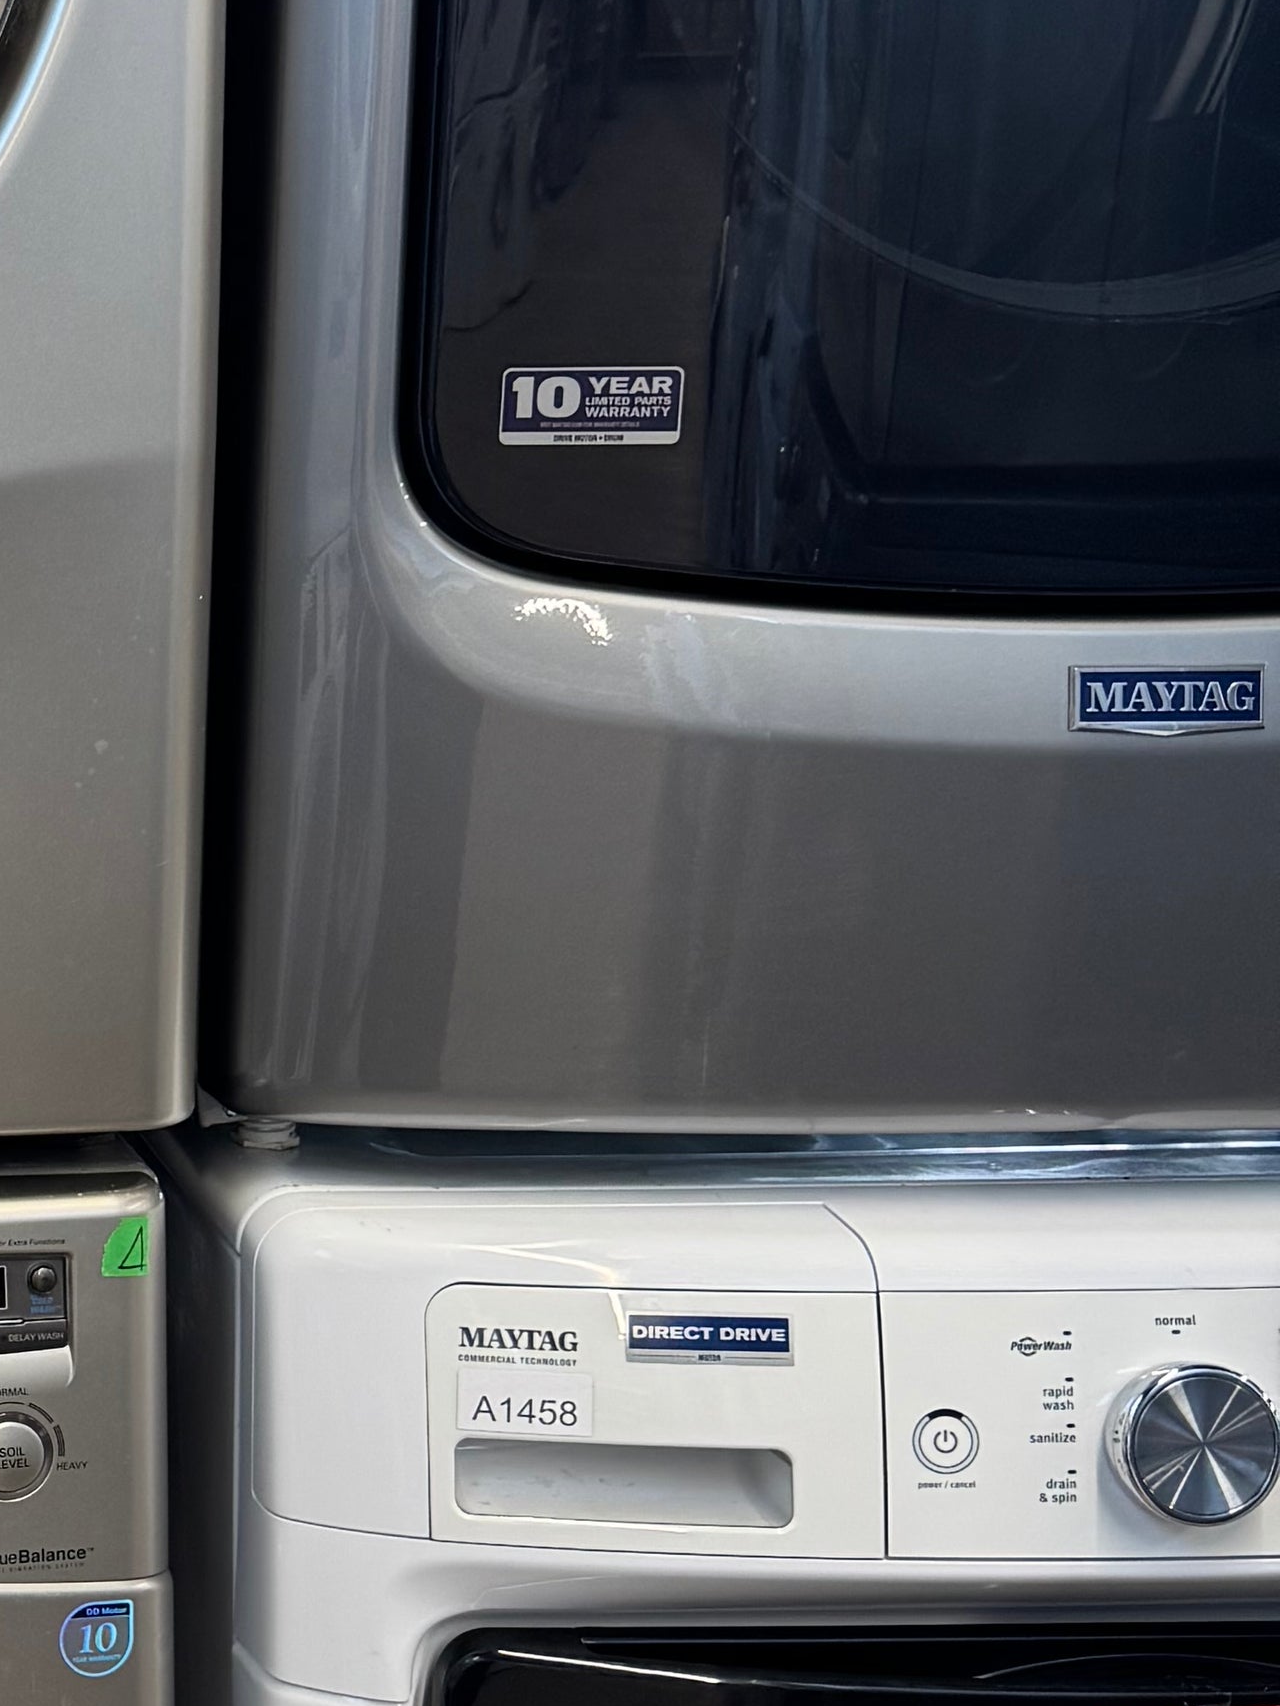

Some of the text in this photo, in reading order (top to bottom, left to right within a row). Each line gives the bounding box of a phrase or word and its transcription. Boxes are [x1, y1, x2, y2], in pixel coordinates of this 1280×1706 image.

[512, 376, 672, 418] 10 YEAR
[586, 396, 672, 406] LIMITED PARTS
[585, 407, 671, 417] WARRANTY
[1086, 681, 1256, 712] MAYTAG
[1156, 1314, 1196, 1326] normal
[458, 1327, 578, 1352] MAYTAG
[632, 1325, 786, 1342] DIRECT DRIVE
[458, 1355, 576, 1367] COMMERCIAL TECHNOLOGY
[1043, 1386, 1074, 1399] rapid
[1043, 1399, 1074, 1410] wash
[472, 1396, 577, 1426] A1458
[1030, 1432, 1076, 1443] sanitize
[0, 1447, 25, 1458] SOIL
[57, 1461, 88, 1471] HEAVY
[1046, 1478, 1077, 1488] drain
[1040, 1492, 1077, 1504] & spin
[80, 1622, 117, 1653] 10
